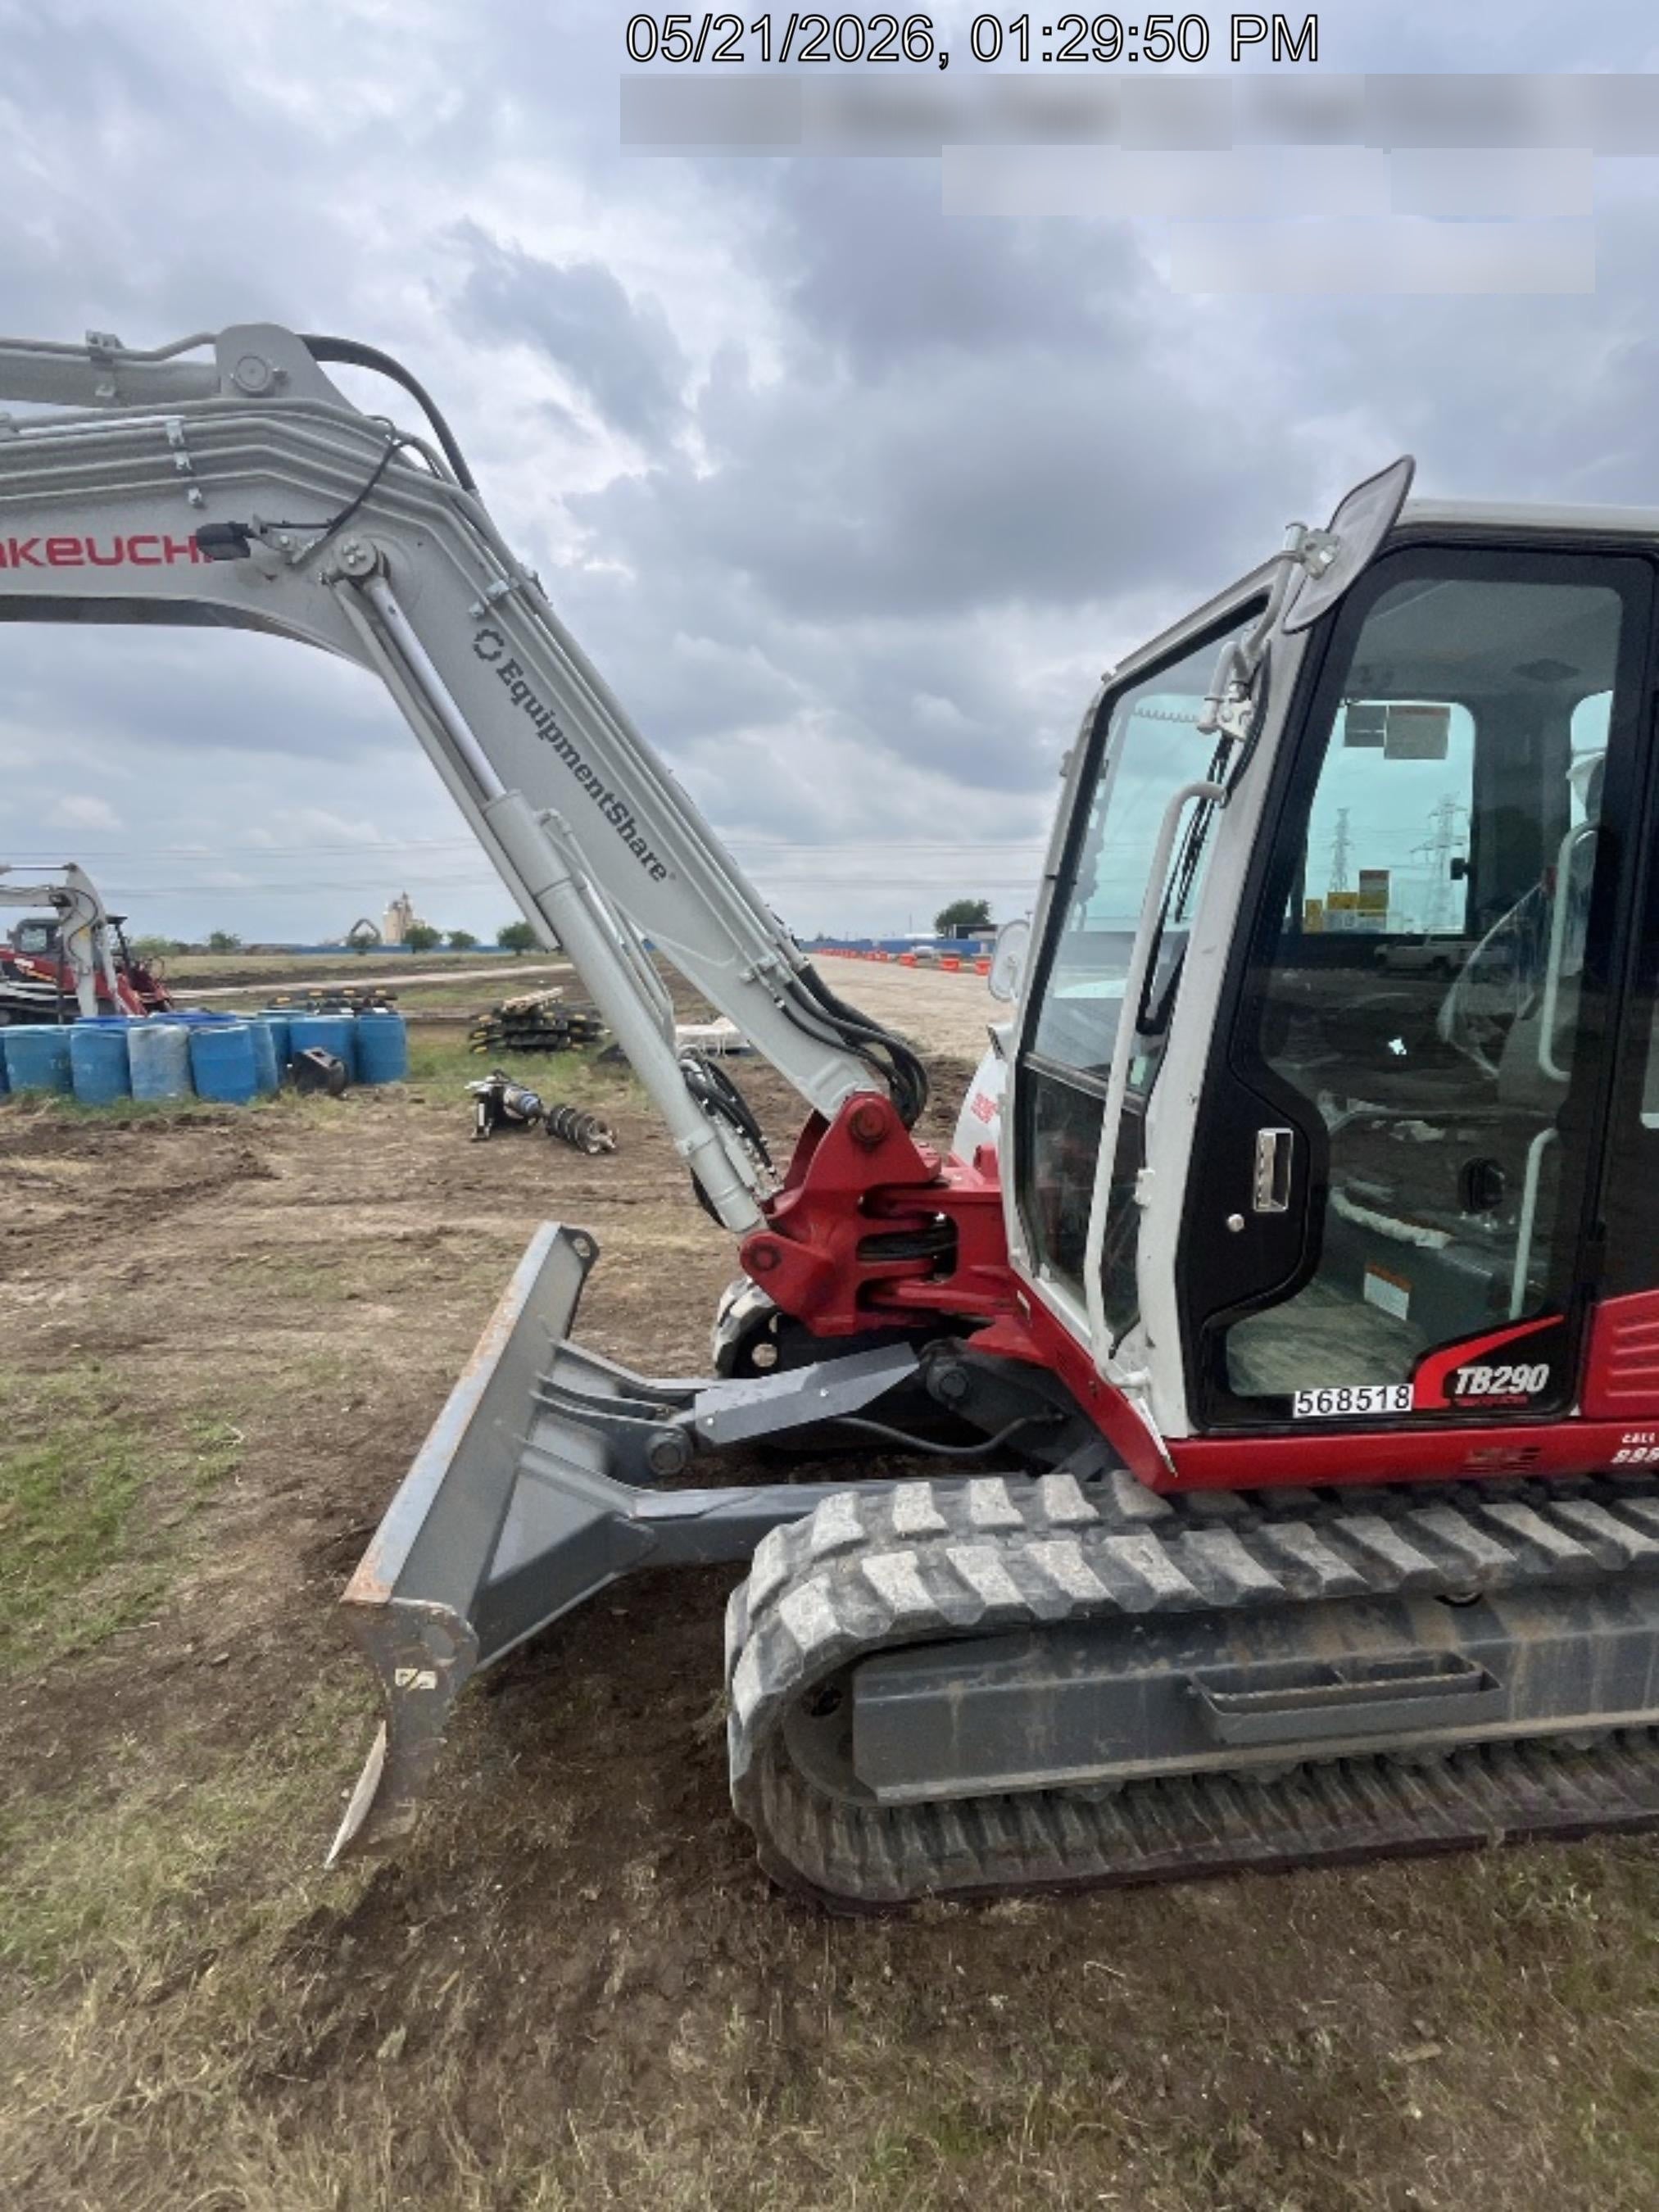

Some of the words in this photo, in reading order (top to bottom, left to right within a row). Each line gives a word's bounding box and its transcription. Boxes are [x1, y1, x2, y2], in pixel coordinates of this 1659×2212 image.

[496, 658, 667, 882] EquipmentShare
[1454, 1364, 1549, 1394] TB290
[1297, 1385, 1410, 1413] 568518
